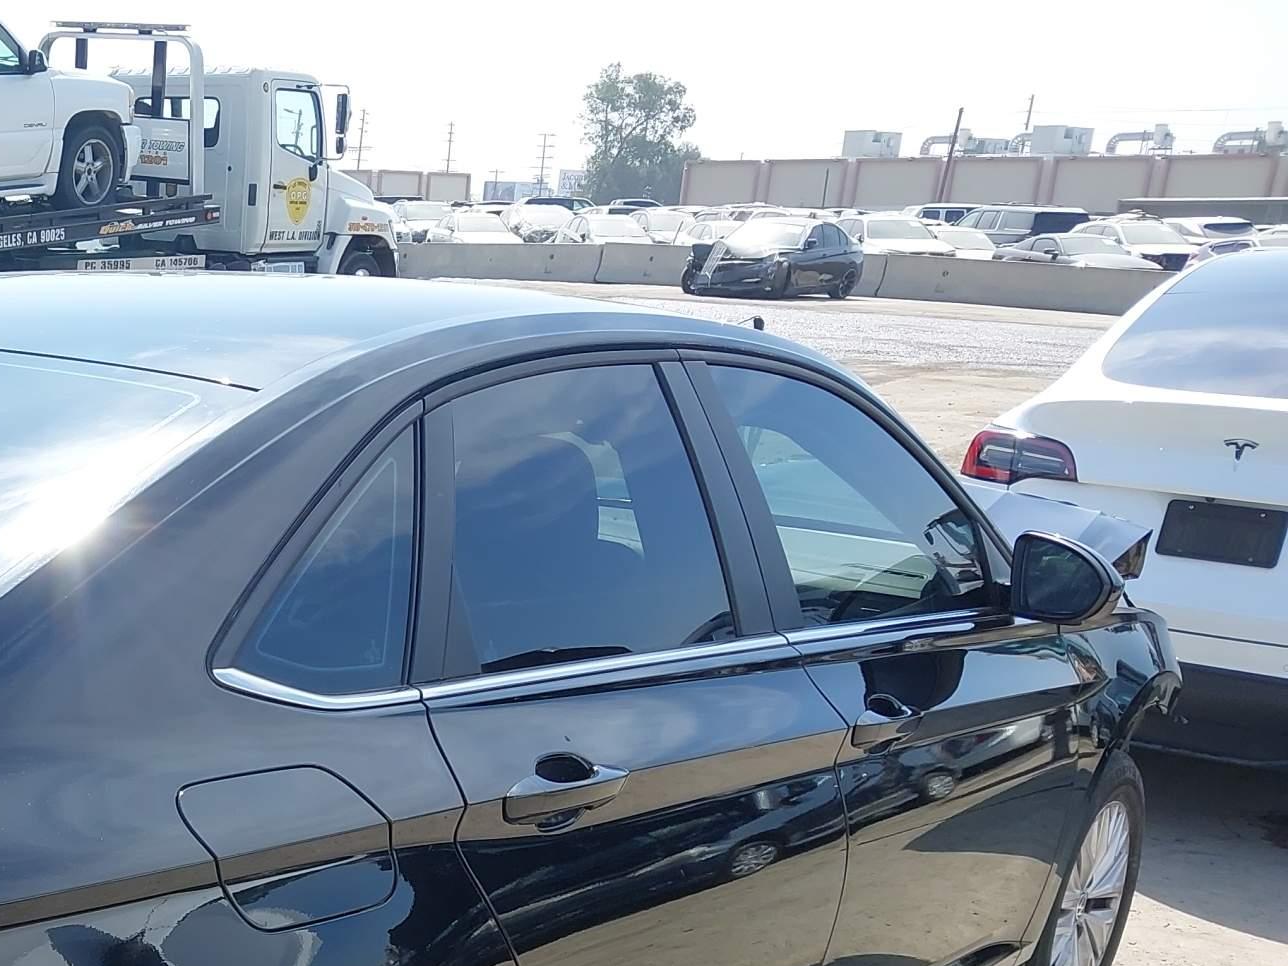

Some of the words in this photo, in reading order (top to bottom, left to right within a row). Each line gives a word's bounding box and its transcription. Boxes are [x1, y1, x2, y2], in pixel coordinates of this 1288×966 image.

[149, 139, 185, 152] TOWING
[27, 231, 38, 245] CA
[40, 227, 66, 243] 90025
[269, 230, 286, 241] WEST
[155, 258, 166, 268] CA
